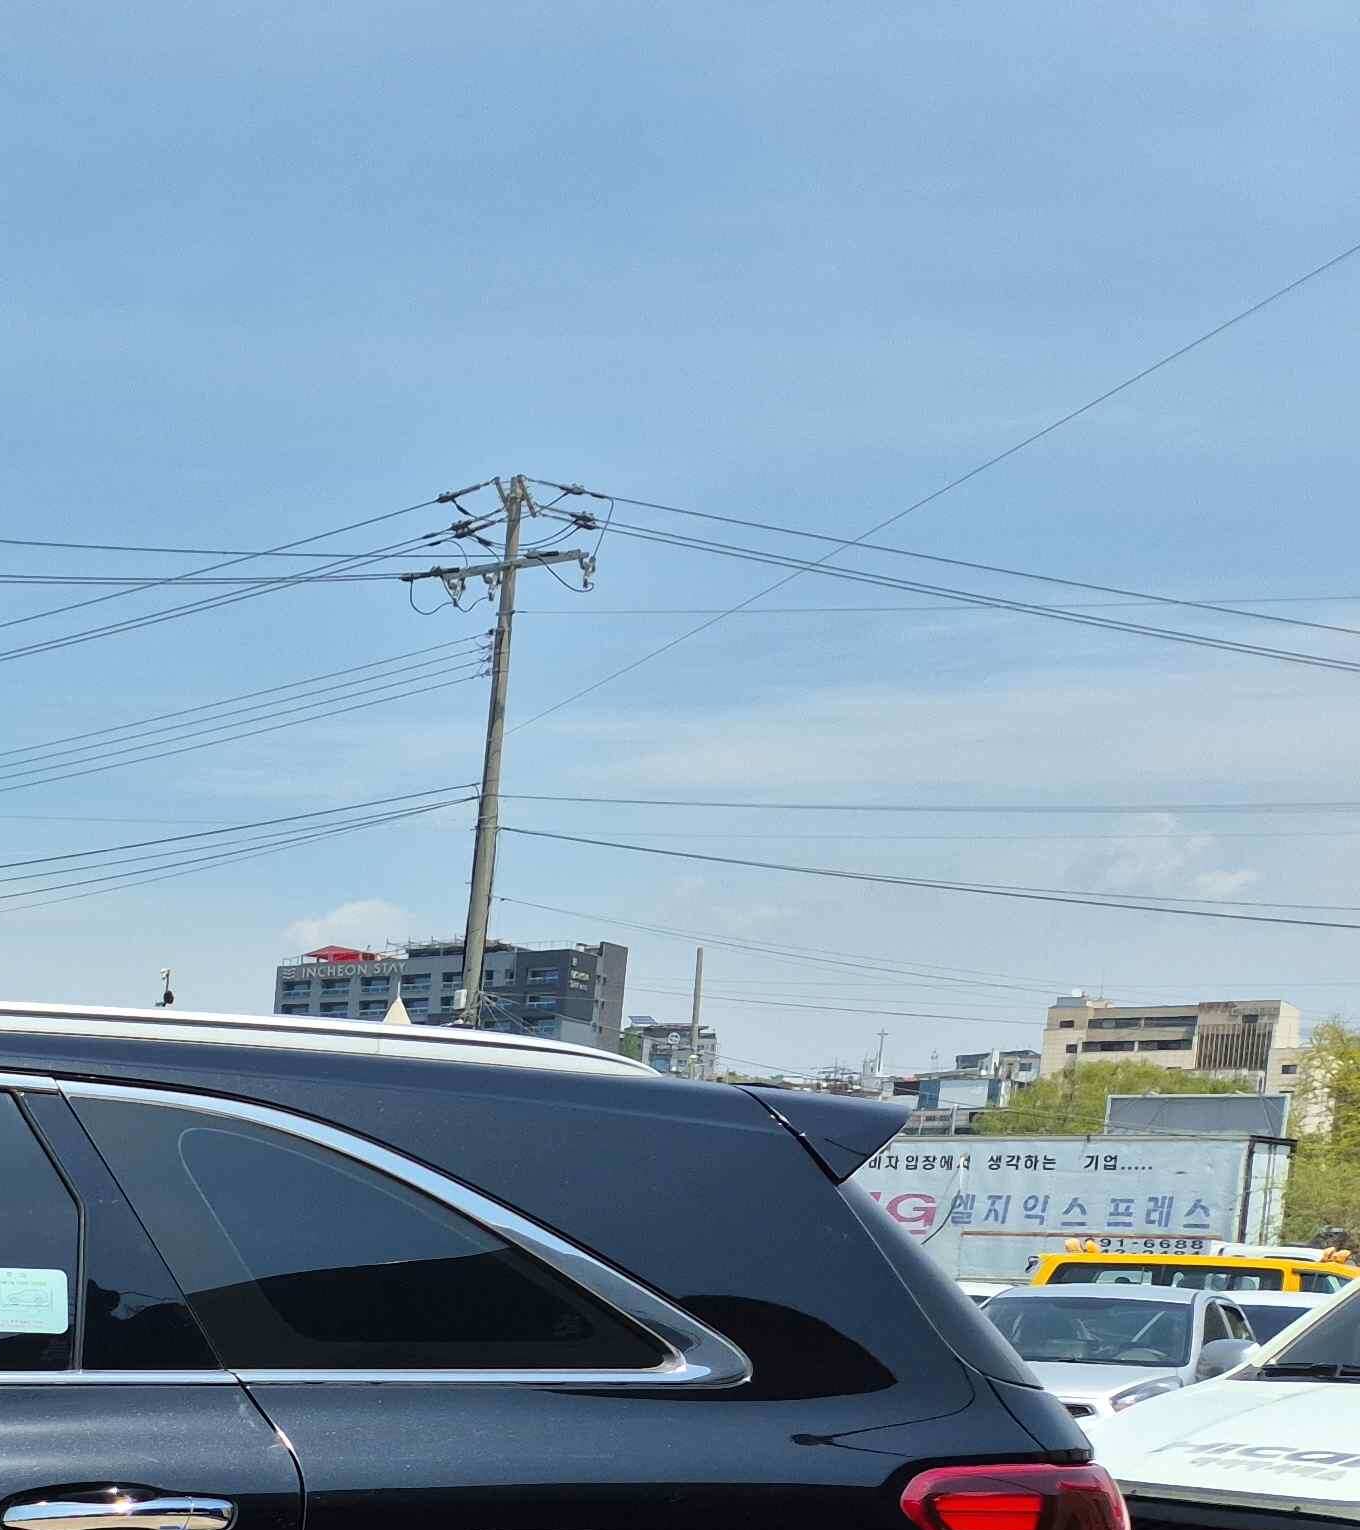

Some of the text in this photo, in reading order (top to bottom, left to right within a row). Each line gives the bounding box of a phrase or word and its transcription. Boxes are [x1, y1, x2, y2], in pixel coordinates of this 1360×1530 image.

[301, 961, 408, 978] INCHEON STAY
[988, 1154, 1056, 1171] 생각하는
